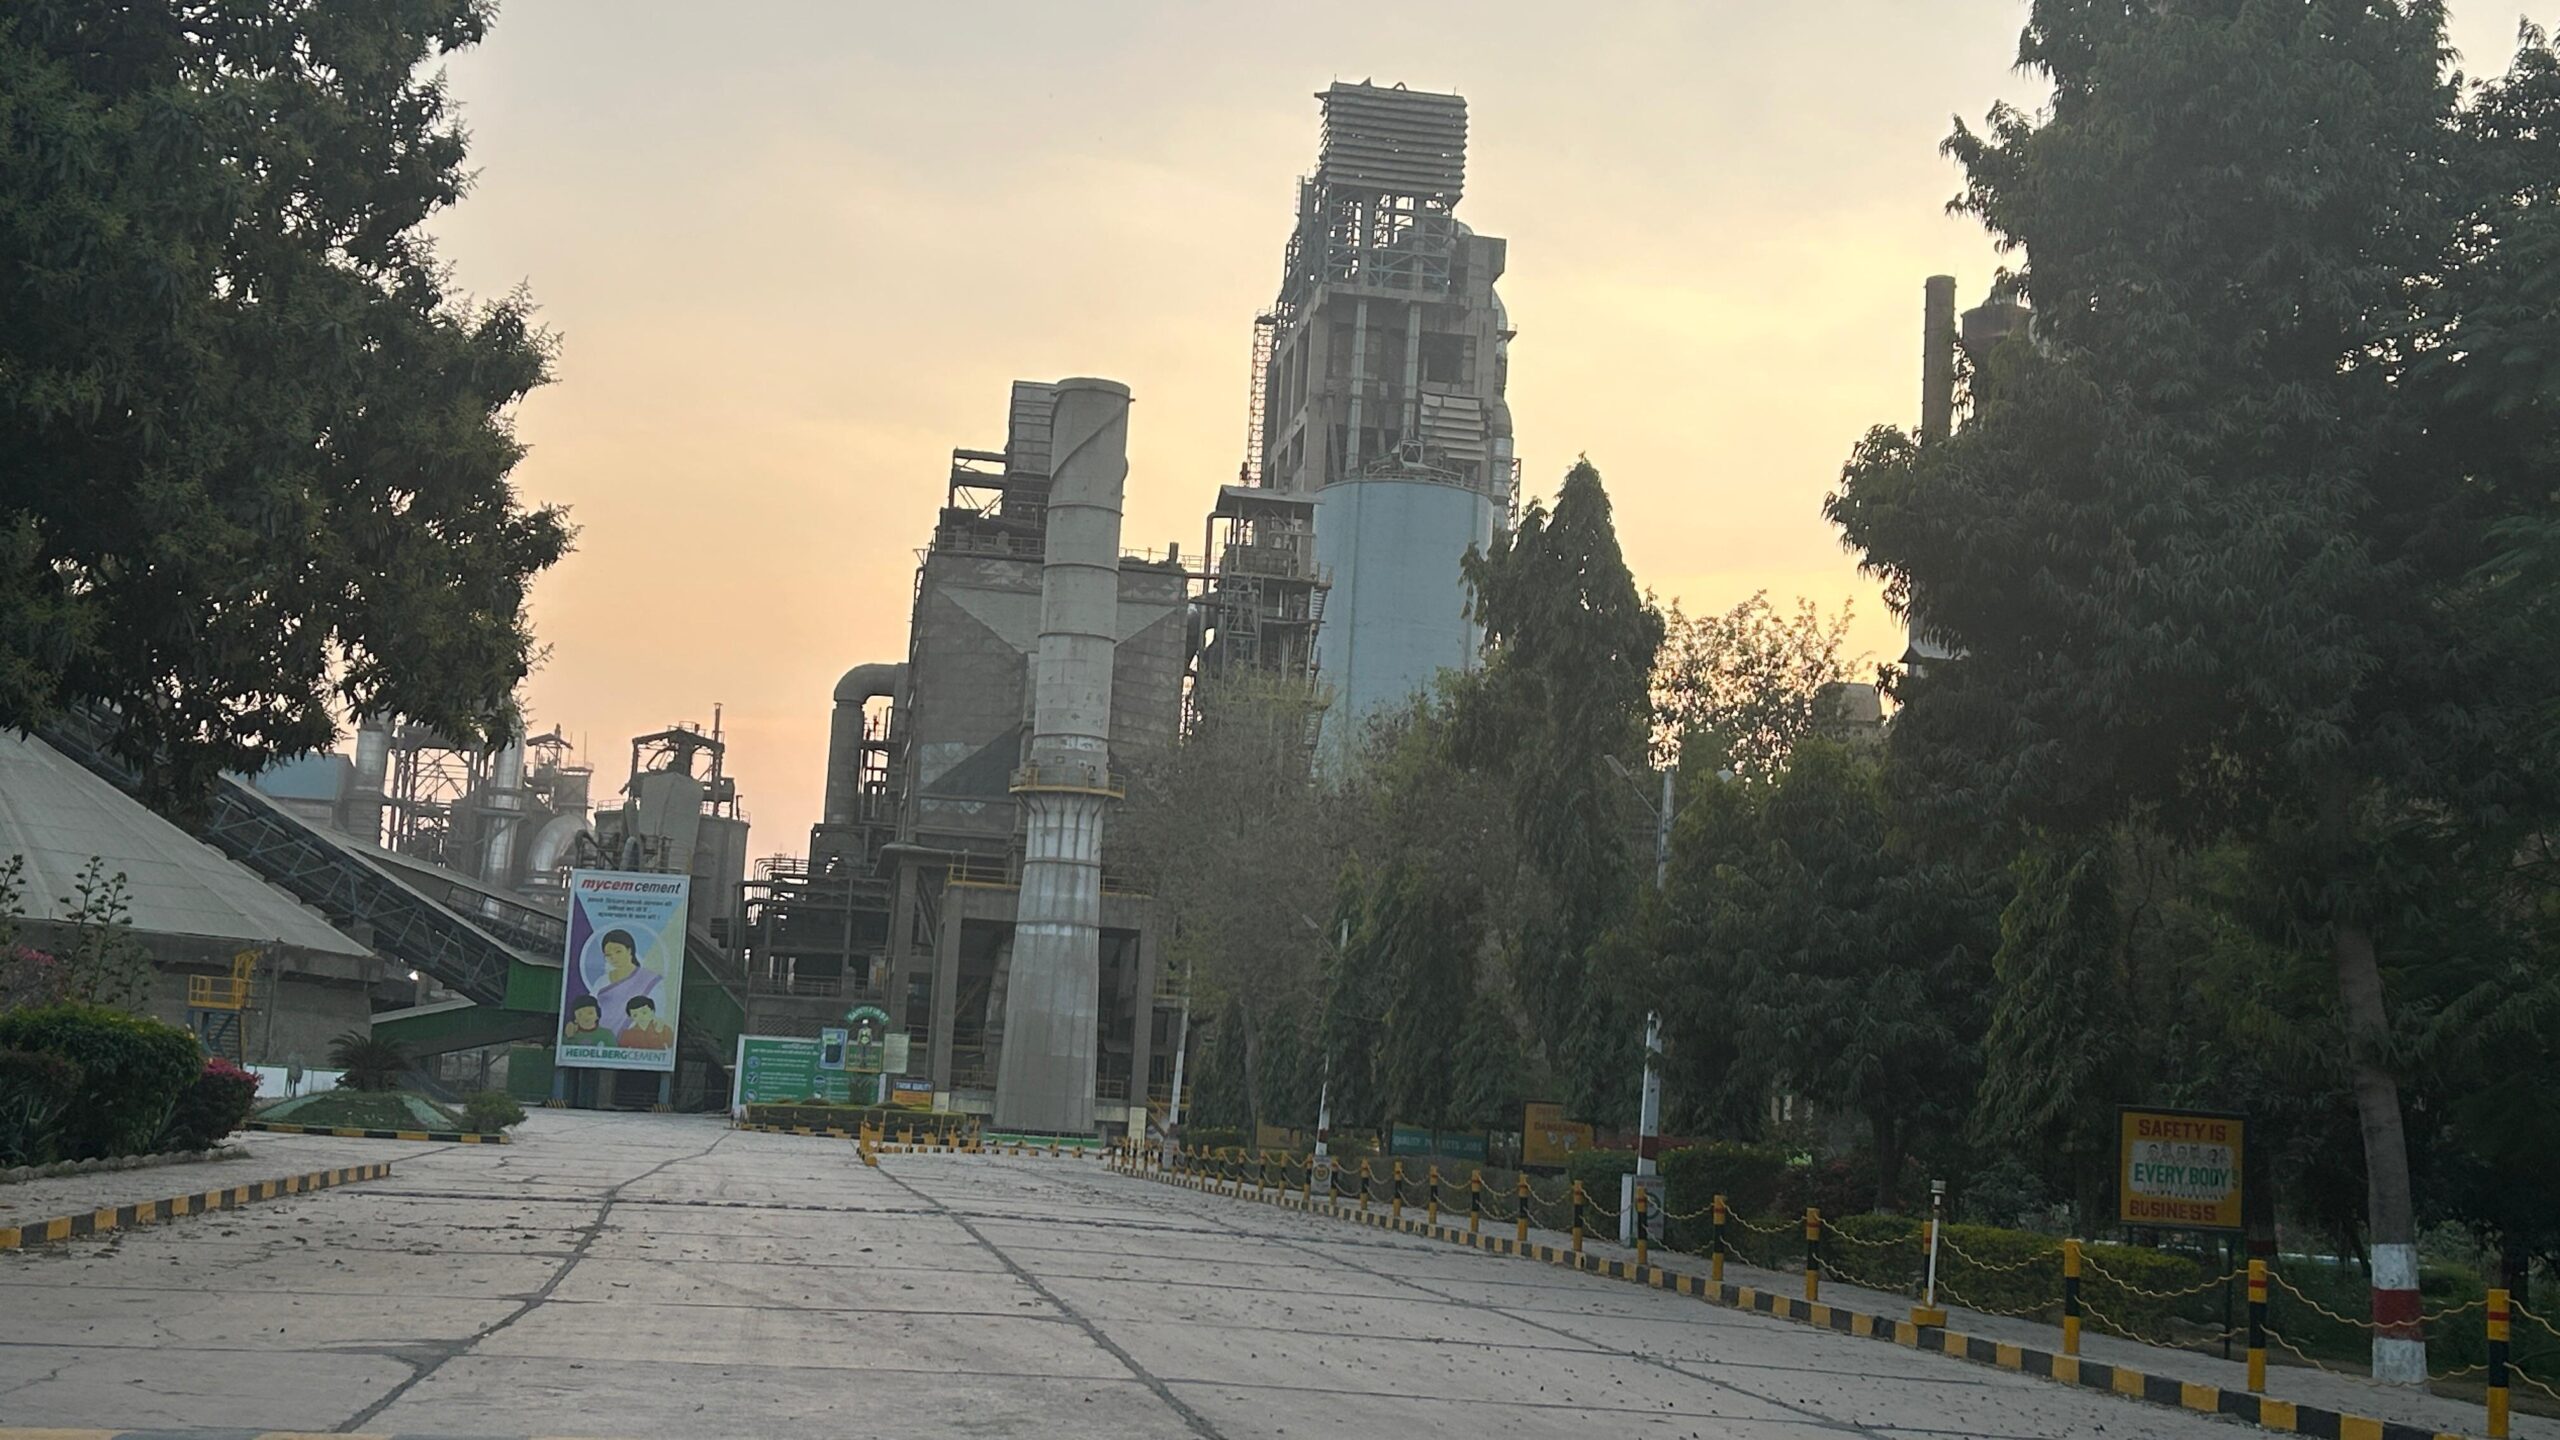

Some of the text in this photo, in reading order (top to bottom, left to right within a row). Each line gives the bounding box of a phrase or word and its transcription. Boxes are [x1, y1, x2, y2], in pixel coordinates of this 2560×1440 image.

[2138, 1119, 2227, 1141] SAFETY IS
[2134, 1162, 2186, 1185] EVERY
[2129, 1199, 2217, 1222] BUSINESS
